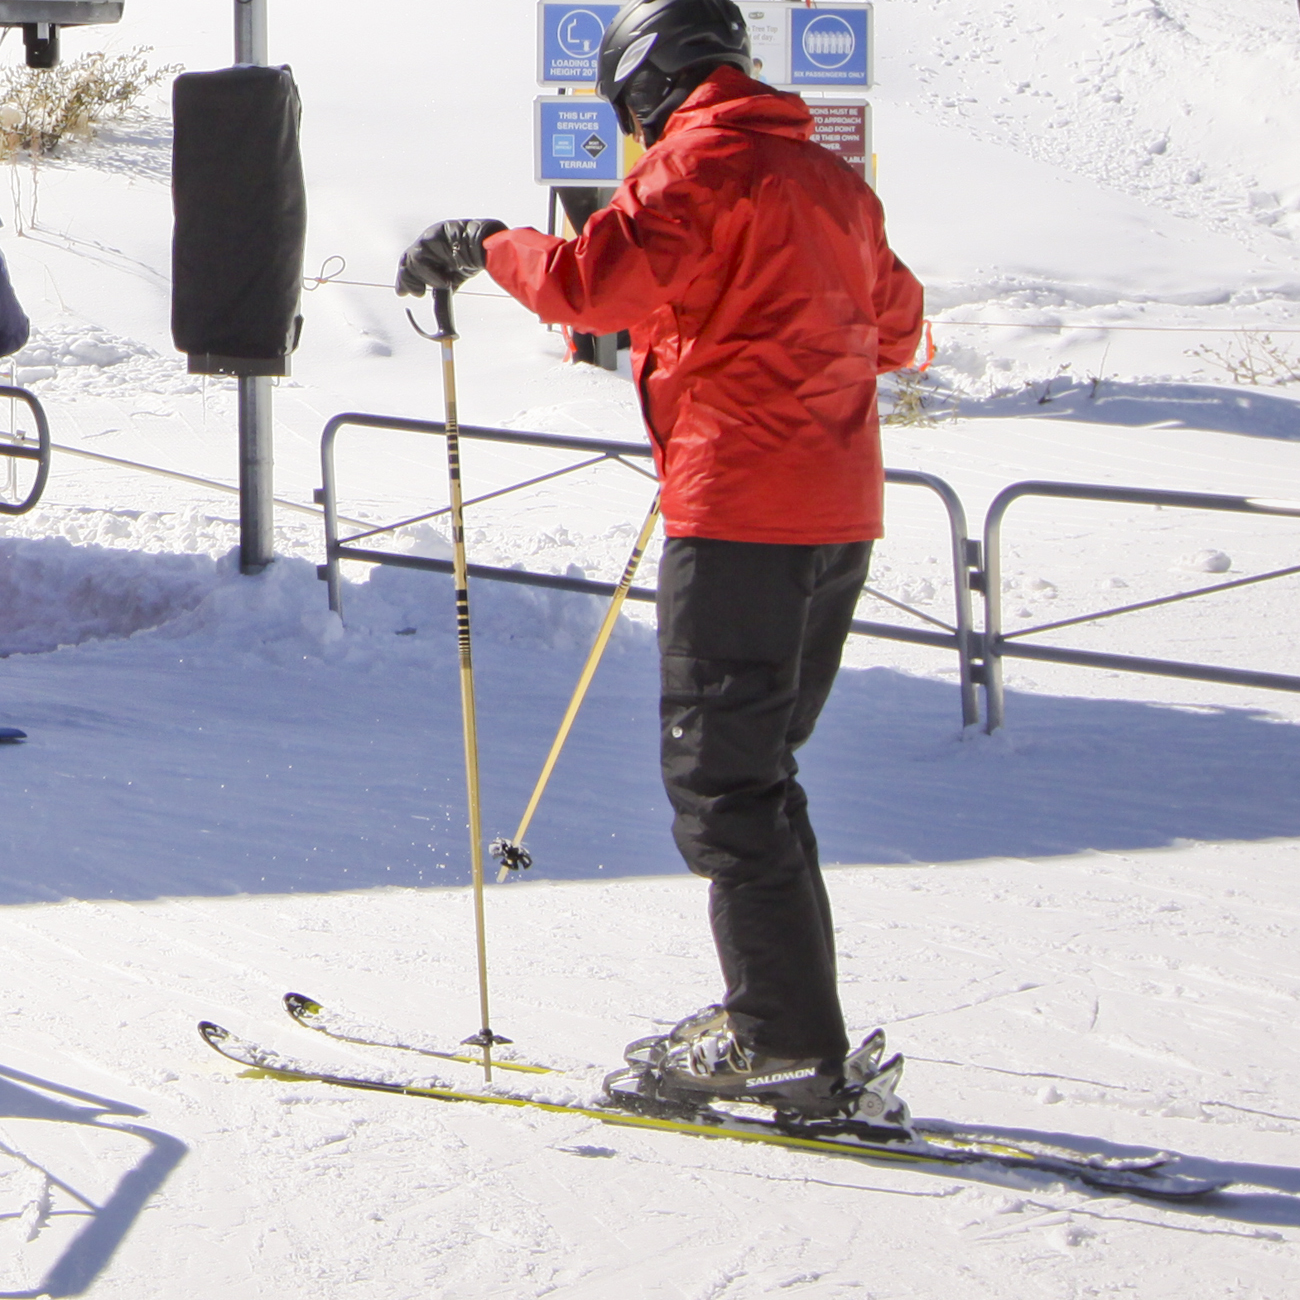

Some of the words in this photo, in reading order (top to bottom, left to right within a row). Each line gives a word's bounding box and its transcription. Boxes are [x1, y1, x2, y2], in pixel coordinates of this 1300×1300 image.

[550, 68, 581, 76] HEIGHT
[580, 112, 598, 120] LIFT
[557, 122, 599, 130] SERVICES
[560, 161, 597, 169] TERRAIN
[745, 1067, 816, 1088] SALOMON
